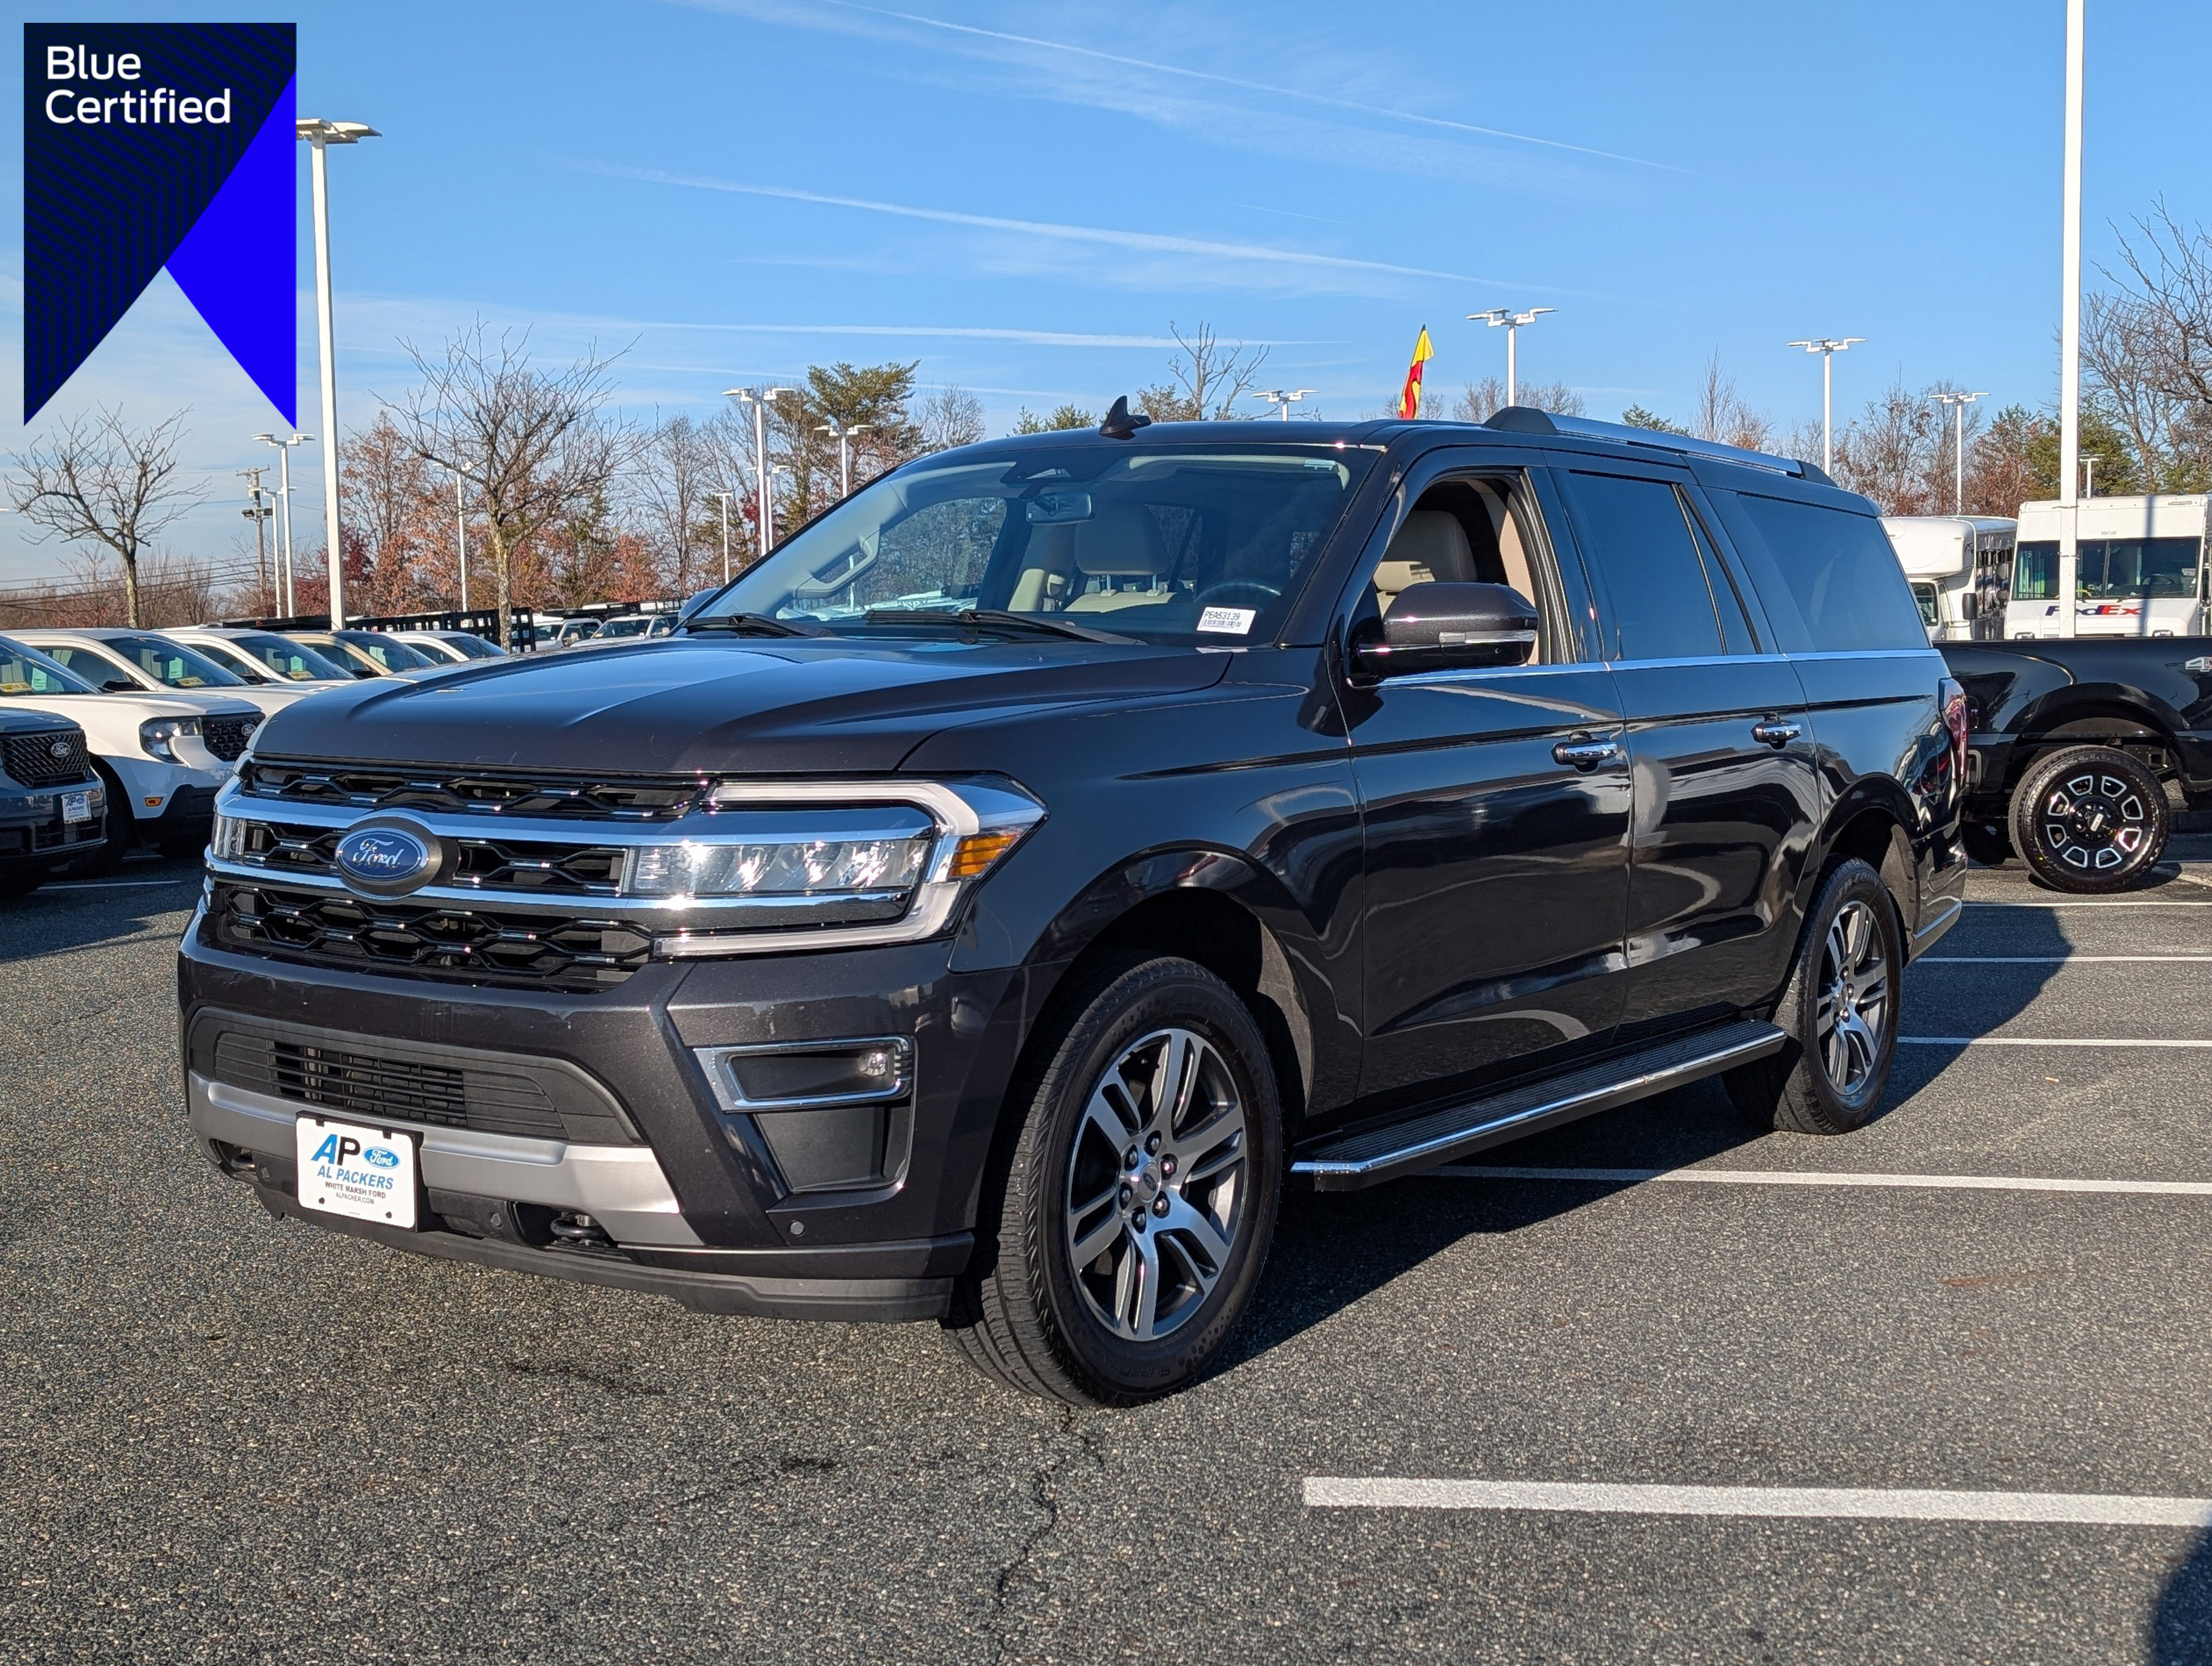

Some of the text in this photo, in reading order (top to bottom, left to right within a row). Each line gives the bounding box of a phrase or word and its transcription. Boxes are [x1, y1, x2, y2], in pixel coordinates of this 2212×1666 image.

[1204, 611, 1240, 620] PEA53139
[353, 838, 405, 866] Ford
[311, 1134, 361, 1166] AP
[317, 1165, 394, 1190] AL PACKERS
[325, 1181, 385, 1199] WHITE MARSH FORD
[336, 1191, 374, 1204] ALPACKER.COM
